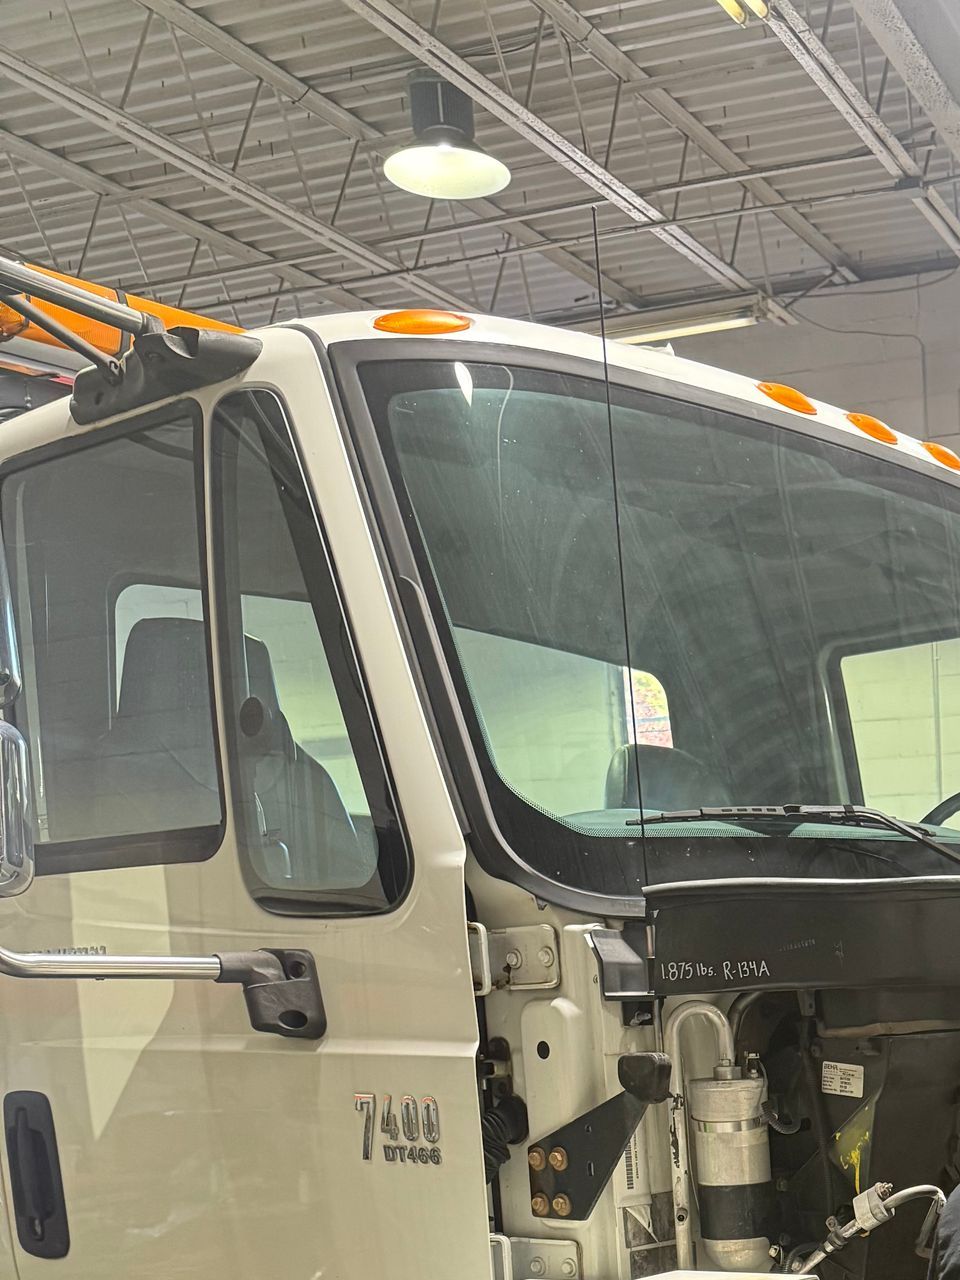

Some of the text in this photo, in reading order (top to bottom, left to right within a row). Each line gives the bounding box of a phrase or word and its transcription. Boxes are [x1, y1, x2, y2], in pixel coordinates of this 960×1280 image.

[661, 959, 770, 981] 1.875 lbs. R-134A
[353, 1092, 440, 1160] 7400
[383, 1144, 442, 1165] DT466
